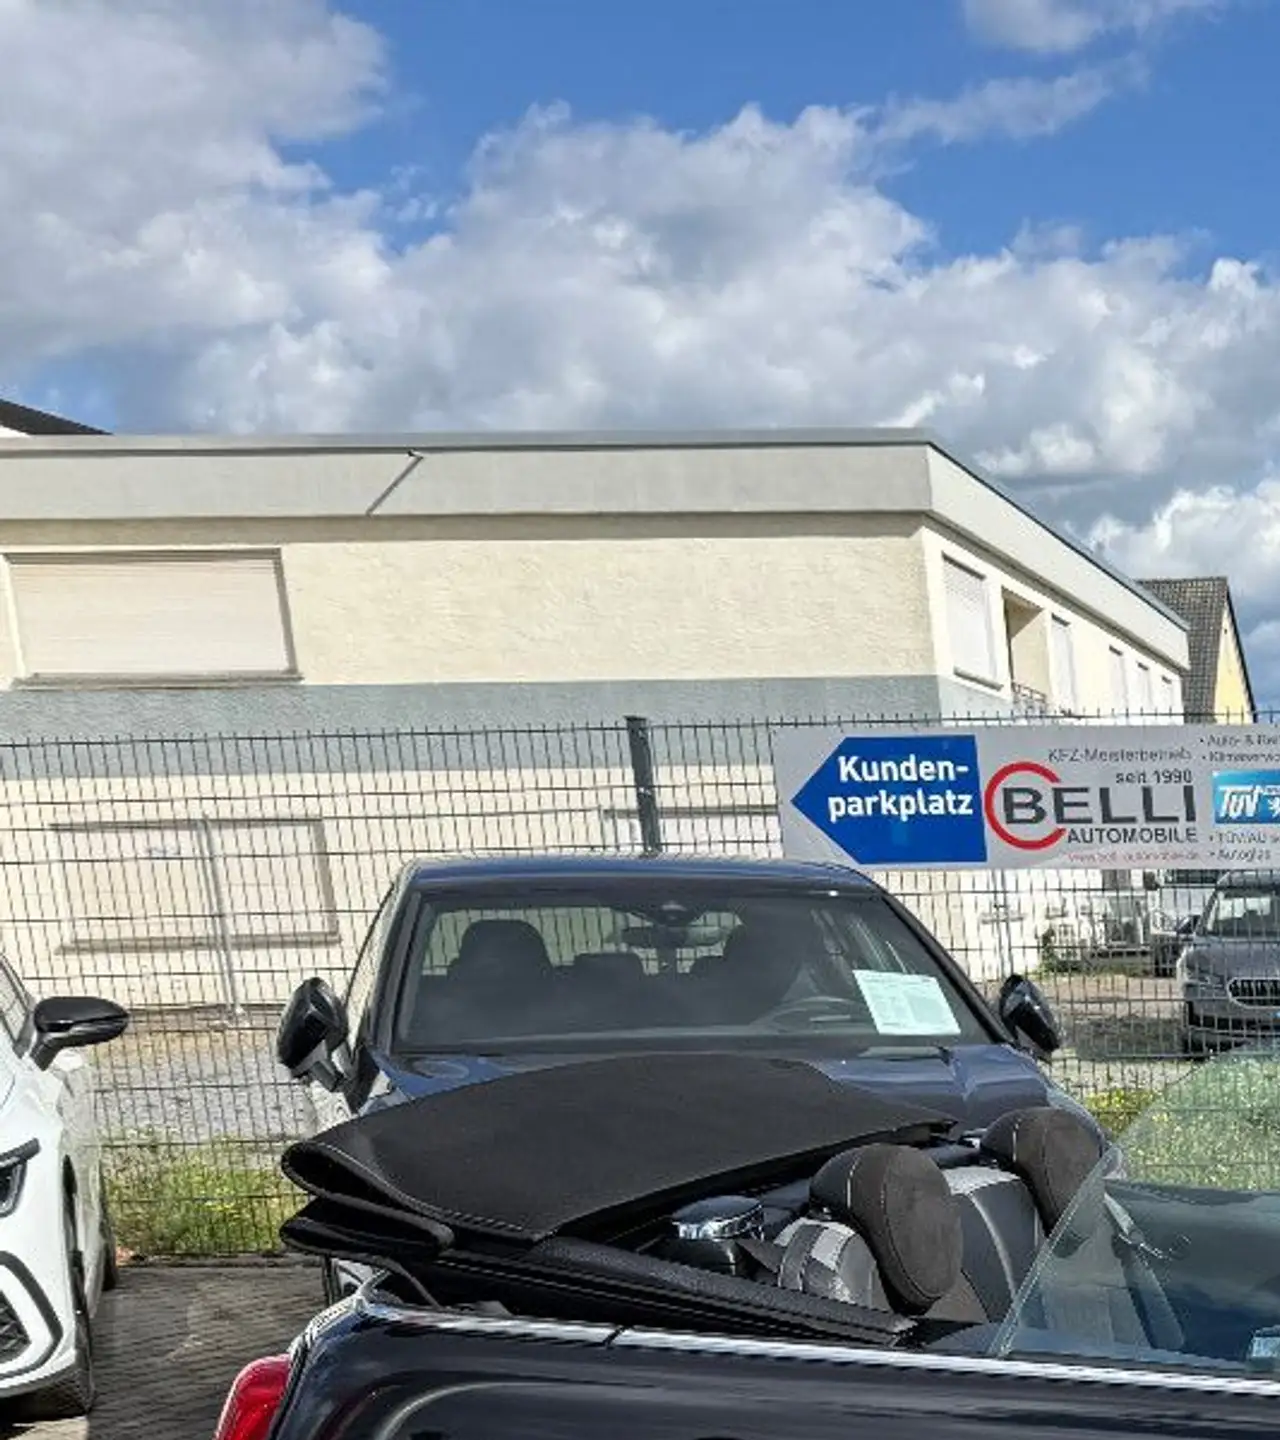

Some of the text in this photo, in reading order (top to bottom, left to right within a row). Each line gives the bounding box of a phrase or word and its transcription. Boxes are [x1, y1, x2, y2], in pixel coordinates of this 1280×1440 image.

[837, 754, 969, 783] Kunden-
[828, 788, 973, 824] parkplatz
[1067, 827, 1199, 844] AUTOMOBILE
